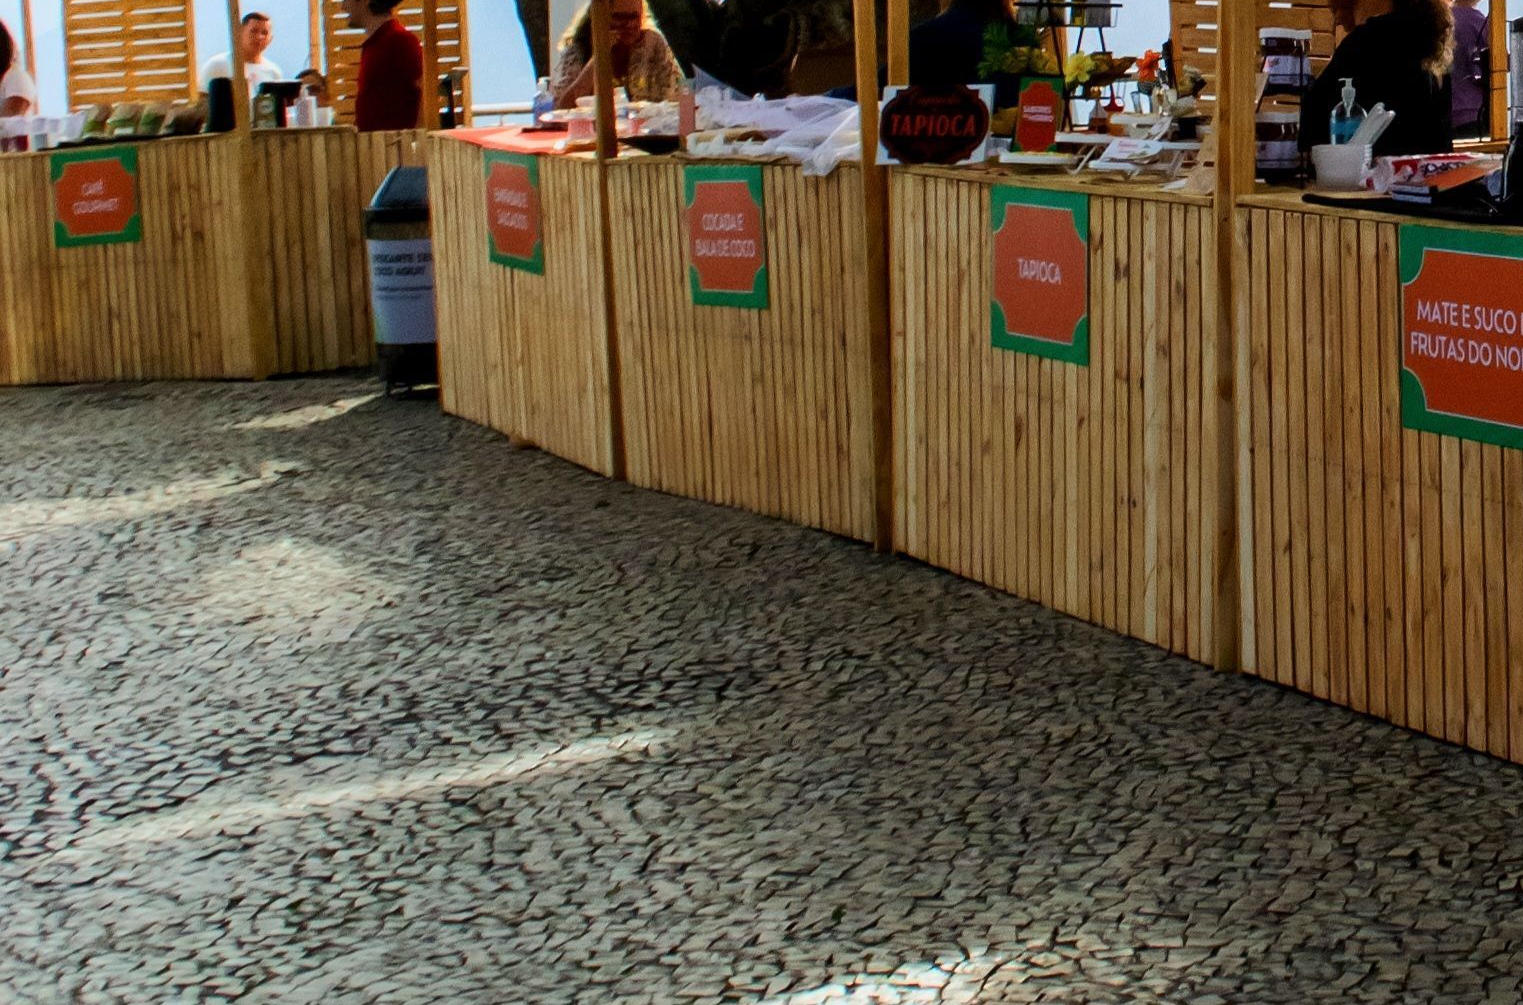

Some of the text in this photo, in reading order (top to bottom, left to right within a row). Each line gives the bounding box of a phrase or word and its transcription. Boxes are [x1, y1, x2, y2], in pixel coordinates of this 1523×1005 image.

[890, 114, 977, 137] TAPIOCA
[702, 213, 737, 231] COCADA
[1018, 258, 1061, 285] TAPIOCA
[1417, 299, 1458, 327] MATE
[1462, 303, 1471, 329] E
[1474, 306, 1517, 334] SUCO
[1410, 331, 1465, 363] FRUTAS
[1468, 340, 1492, 366] DO
